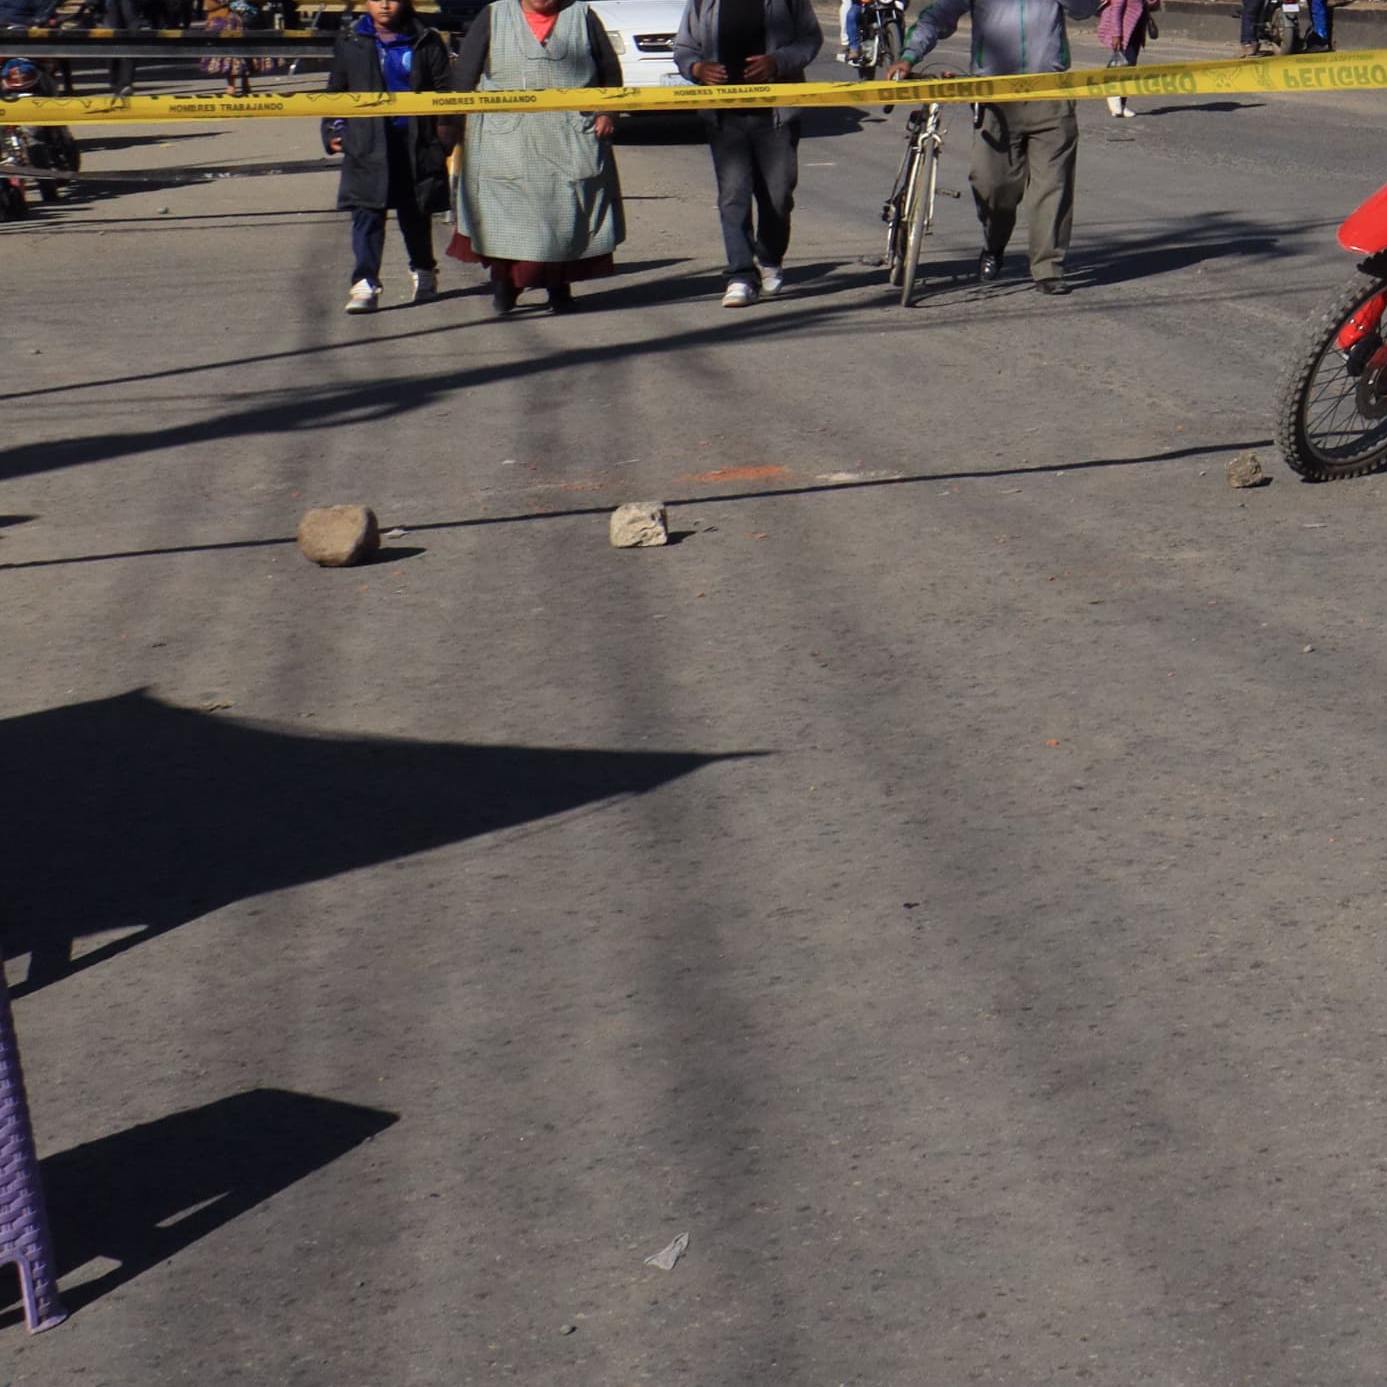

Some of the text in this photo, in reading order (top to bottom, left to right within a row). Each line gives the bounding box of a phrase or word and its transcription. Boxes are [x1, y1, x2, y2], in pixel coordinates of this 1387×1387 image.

[674, 86, 771, 97] HOMBRES TRABAJANDO
[432, 95, 537, 106] HOMBRES TRABAJANDO
[169, 102, 284, 112] HOMBRES TRABAJANDO
